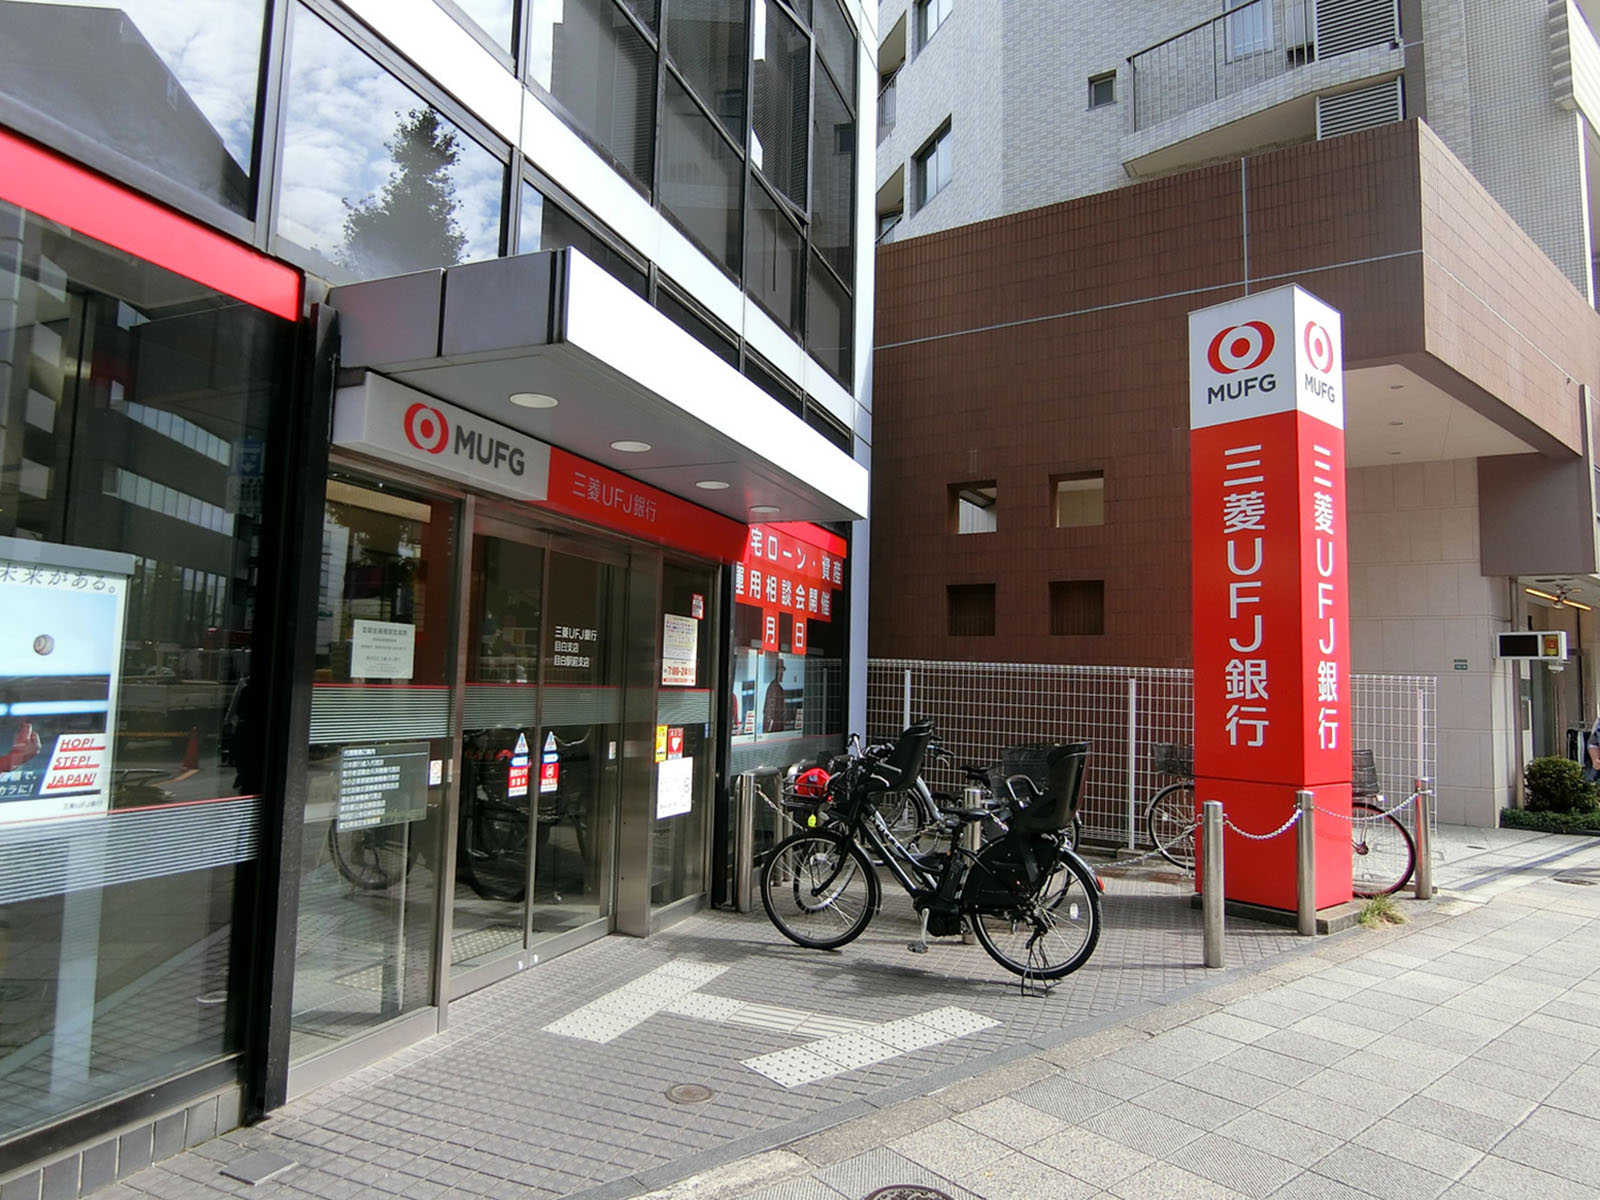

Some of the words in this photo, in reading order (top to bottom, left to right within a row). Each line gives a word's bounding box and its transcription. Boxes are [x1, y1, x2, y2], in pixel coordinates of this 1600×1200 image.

[1207, 373, 1277, 405] MUFG
[1304, 372, 1335, 404] MUFG
[454, 424, 526, 477] MUFG
[571, 471, 658, 524] 三菱UFJ銀行
[1222, 443, 1270, 749] 三菱UFJ銀行
[1312, 443, 1341, 751] 三菱UFJ銀行
[554, 625, 598, 641] 三菱UFJ銀行
[554, 640, 580, 653] 目白支店
[765, 616, 776, 644] 月
[795, 621, 804, 648] 日
[60, 737, 95, 749] HOP!
[55, 755, 92, 767] STEP!
[50, 773, 97, 785] JAPAN!
